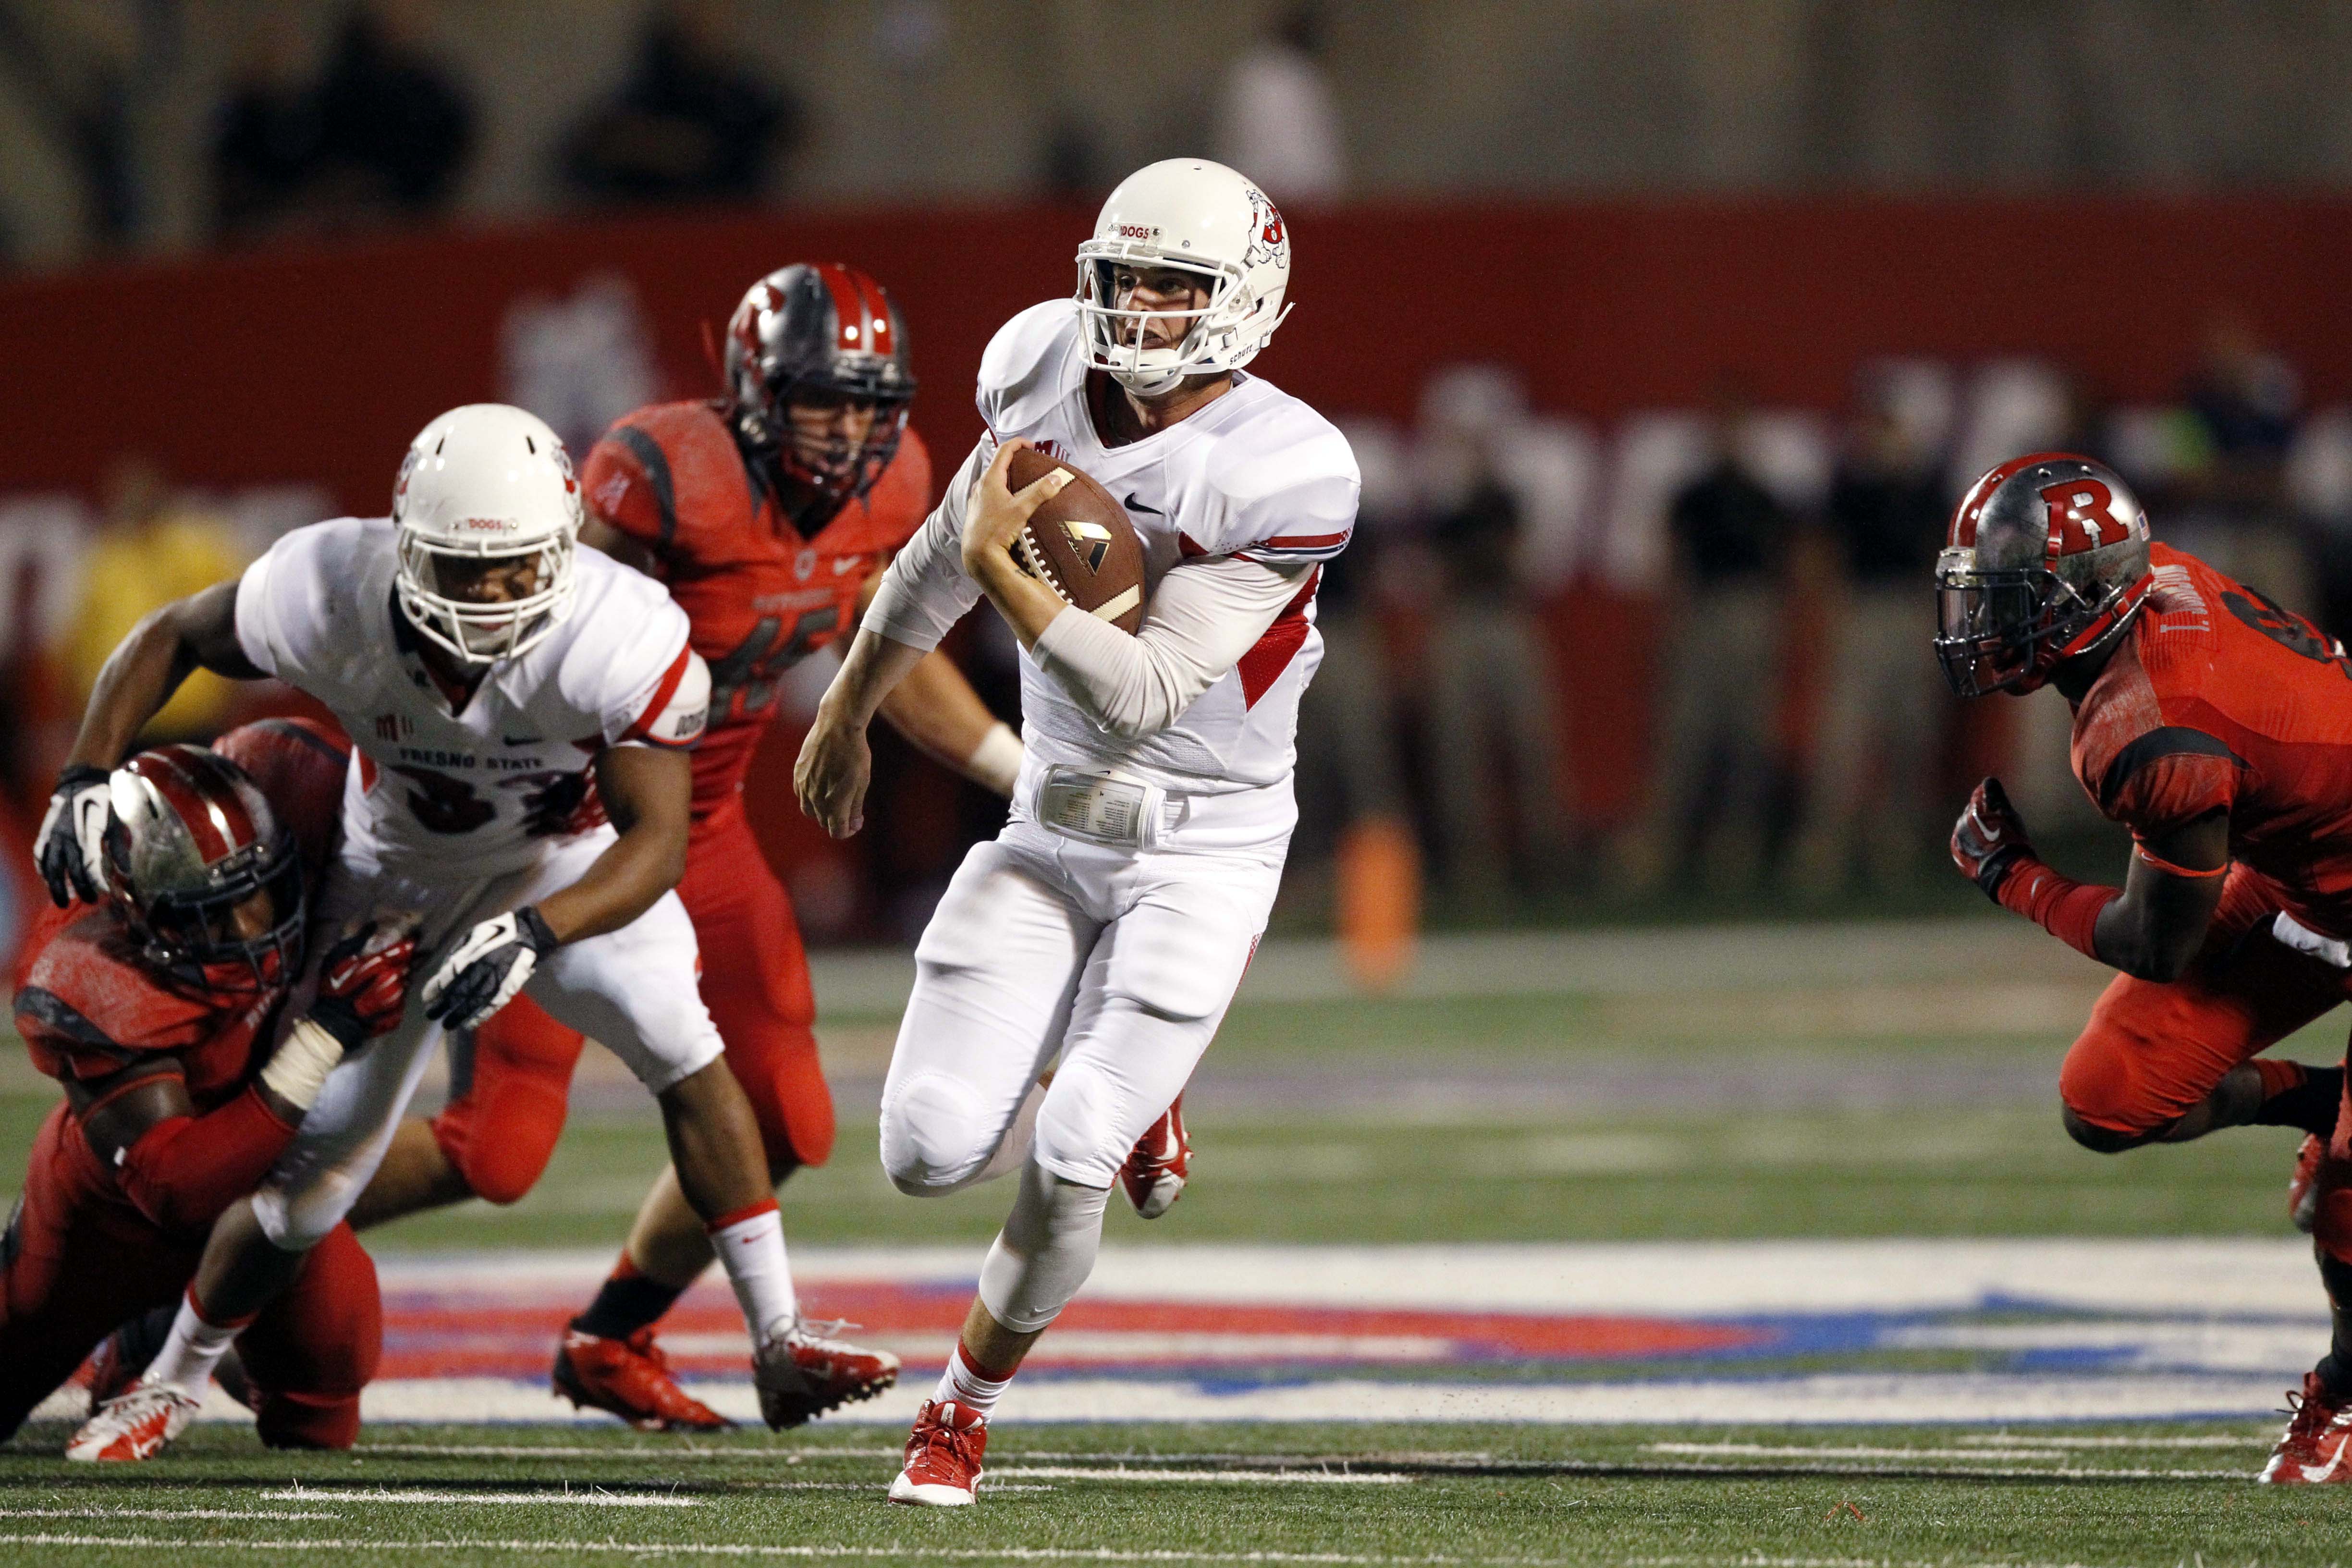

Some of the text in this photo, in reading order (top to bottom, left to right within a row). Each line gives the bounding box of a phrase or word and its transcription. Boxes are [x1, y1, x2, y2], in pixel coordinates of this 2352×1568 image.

[468, 518, 503, 529] DOGS
[2040, 478, 2129, 557] R
[400, 747, 543, 769] FRESNO STATE
